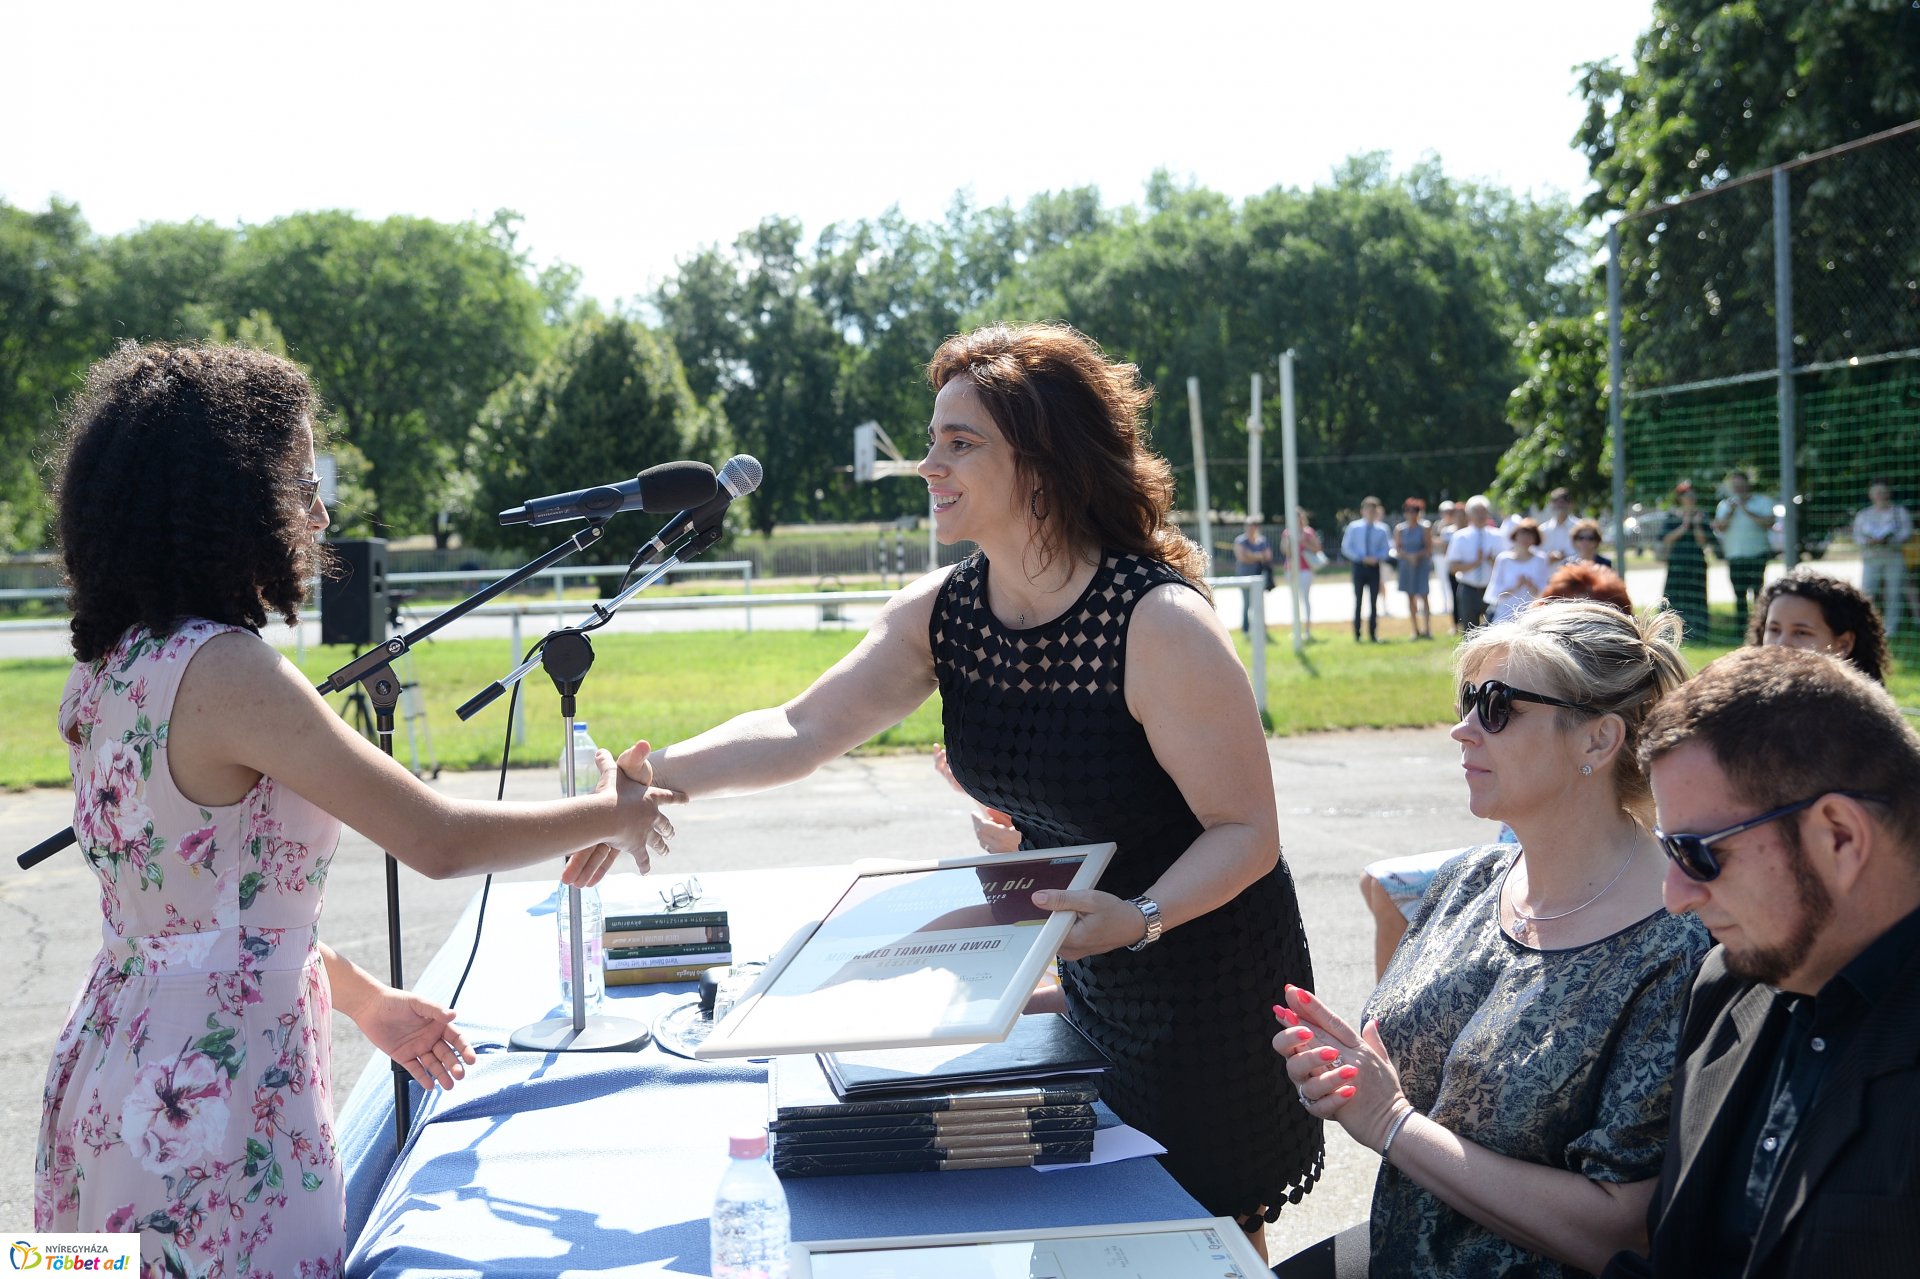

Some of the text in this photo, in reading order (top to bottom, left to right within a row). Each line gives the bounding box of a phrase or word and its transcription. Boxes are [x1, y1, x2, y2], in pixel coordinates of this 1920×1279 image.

[1002, 877, 1035, 891] DÍJ
[654, 917, 688, 925] KRISZTINA
[894, 943, 957, 956] TAMIMAH
[959, 939, 1002, 951] AWAD
[676, 969, 696, 978] Magda
